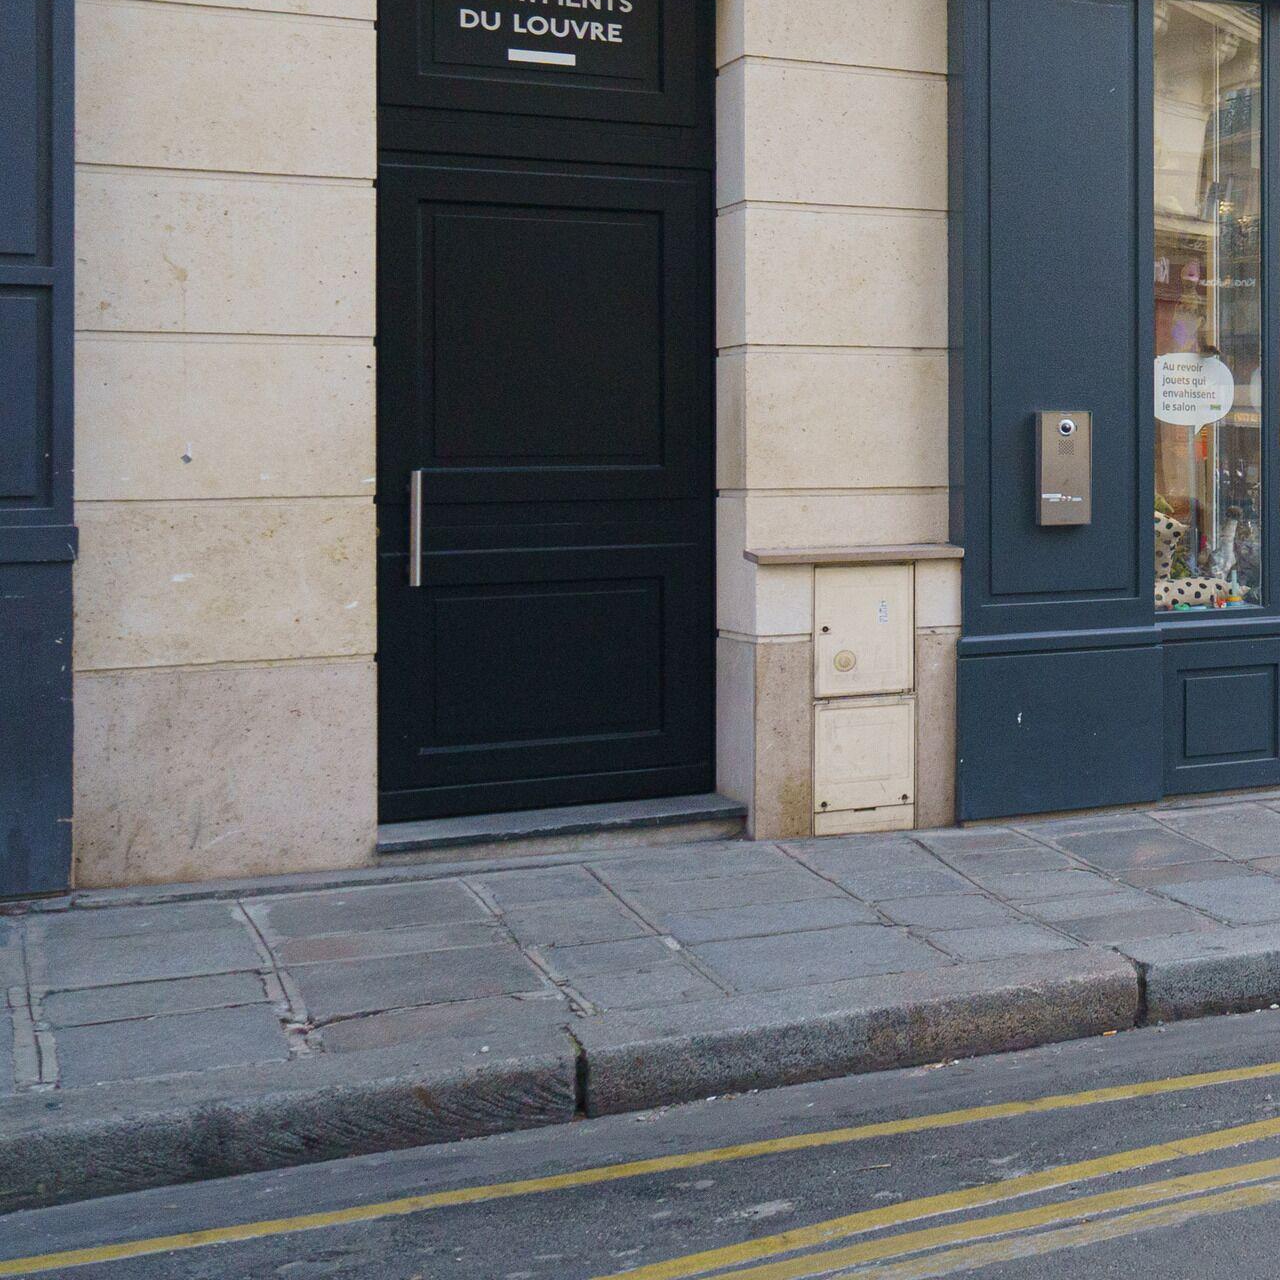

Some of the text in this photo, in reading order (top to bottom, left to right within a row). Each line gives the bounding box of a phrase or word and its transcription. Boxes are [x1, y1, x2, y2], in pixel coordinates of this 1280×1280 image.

[460, 8, 623, 43] DU LOUVRE
[1162, 361, 1203, 372] Au revoir
[1162, 376, 1206, 387] jouets qui
[1162, 389, 1216, 399] envahissent
[1162, 402, 1196, 412] le salon
